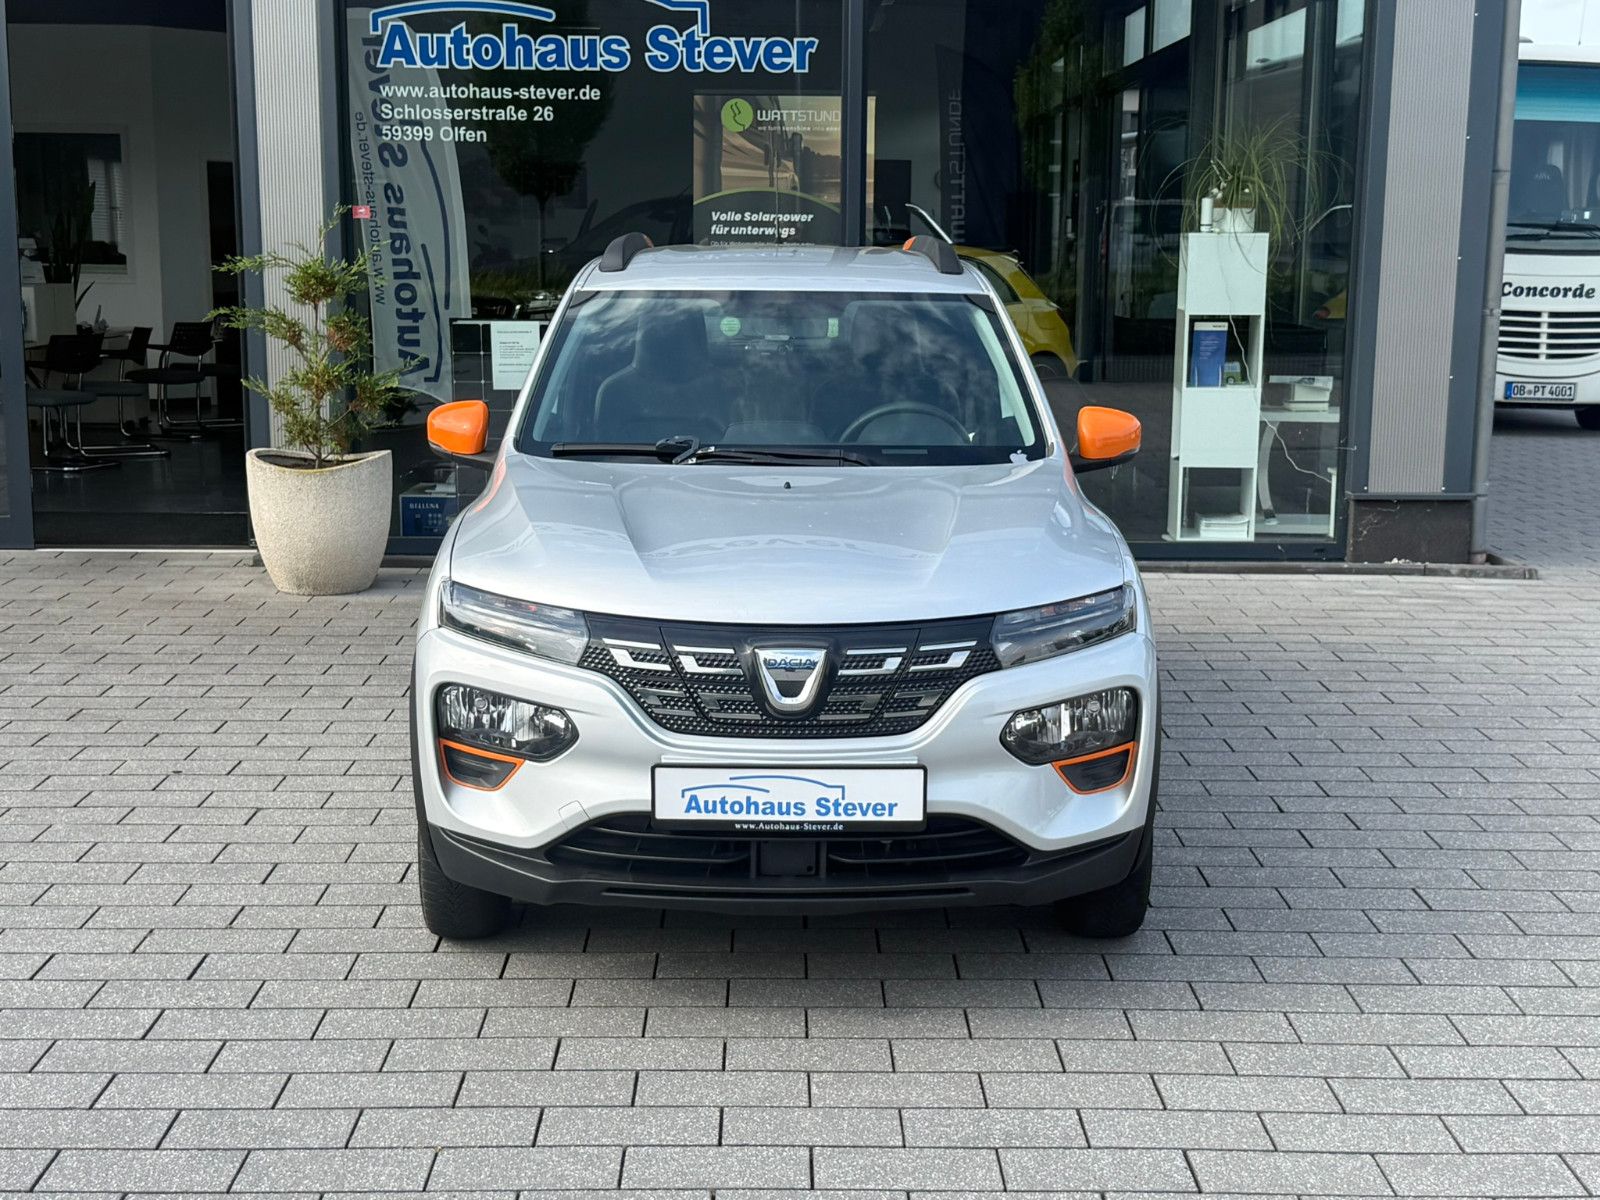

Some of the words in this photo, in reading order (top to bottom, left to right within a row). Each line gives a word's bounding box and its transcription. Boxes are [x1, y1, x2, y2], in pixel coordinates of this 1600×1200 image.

[376, 21, 630, 72] Autohaus
[645, 24, 819, 73] Stever
[379, 83, 601, 100] www.autohaus-stever.de
[380, 103, 528, 121] Schlosserstraße
[532, 105, 554, 121] 26
[757, 110, 841, 122] WATTSTUND
[381, 125, 433, 142] 59399
[439, 126, 488, 143] Olfen
[711, 211, 742, 222] Volle
[711, 224, 729, 235] für
[1502, 281, 1596, 299] Concorde
[1512, 385, 1526, 396] OB
[1533, 386, 1547, 396] PT
[1548, 386, 1573, 397] 4001
[767, 658, 815, 667] DACIA
[684, 794, 806, 816] Autohaus
[815, 798, 898, 816] Stever
[734, 821, 844, 831] www.Autohaus-Stever.de
